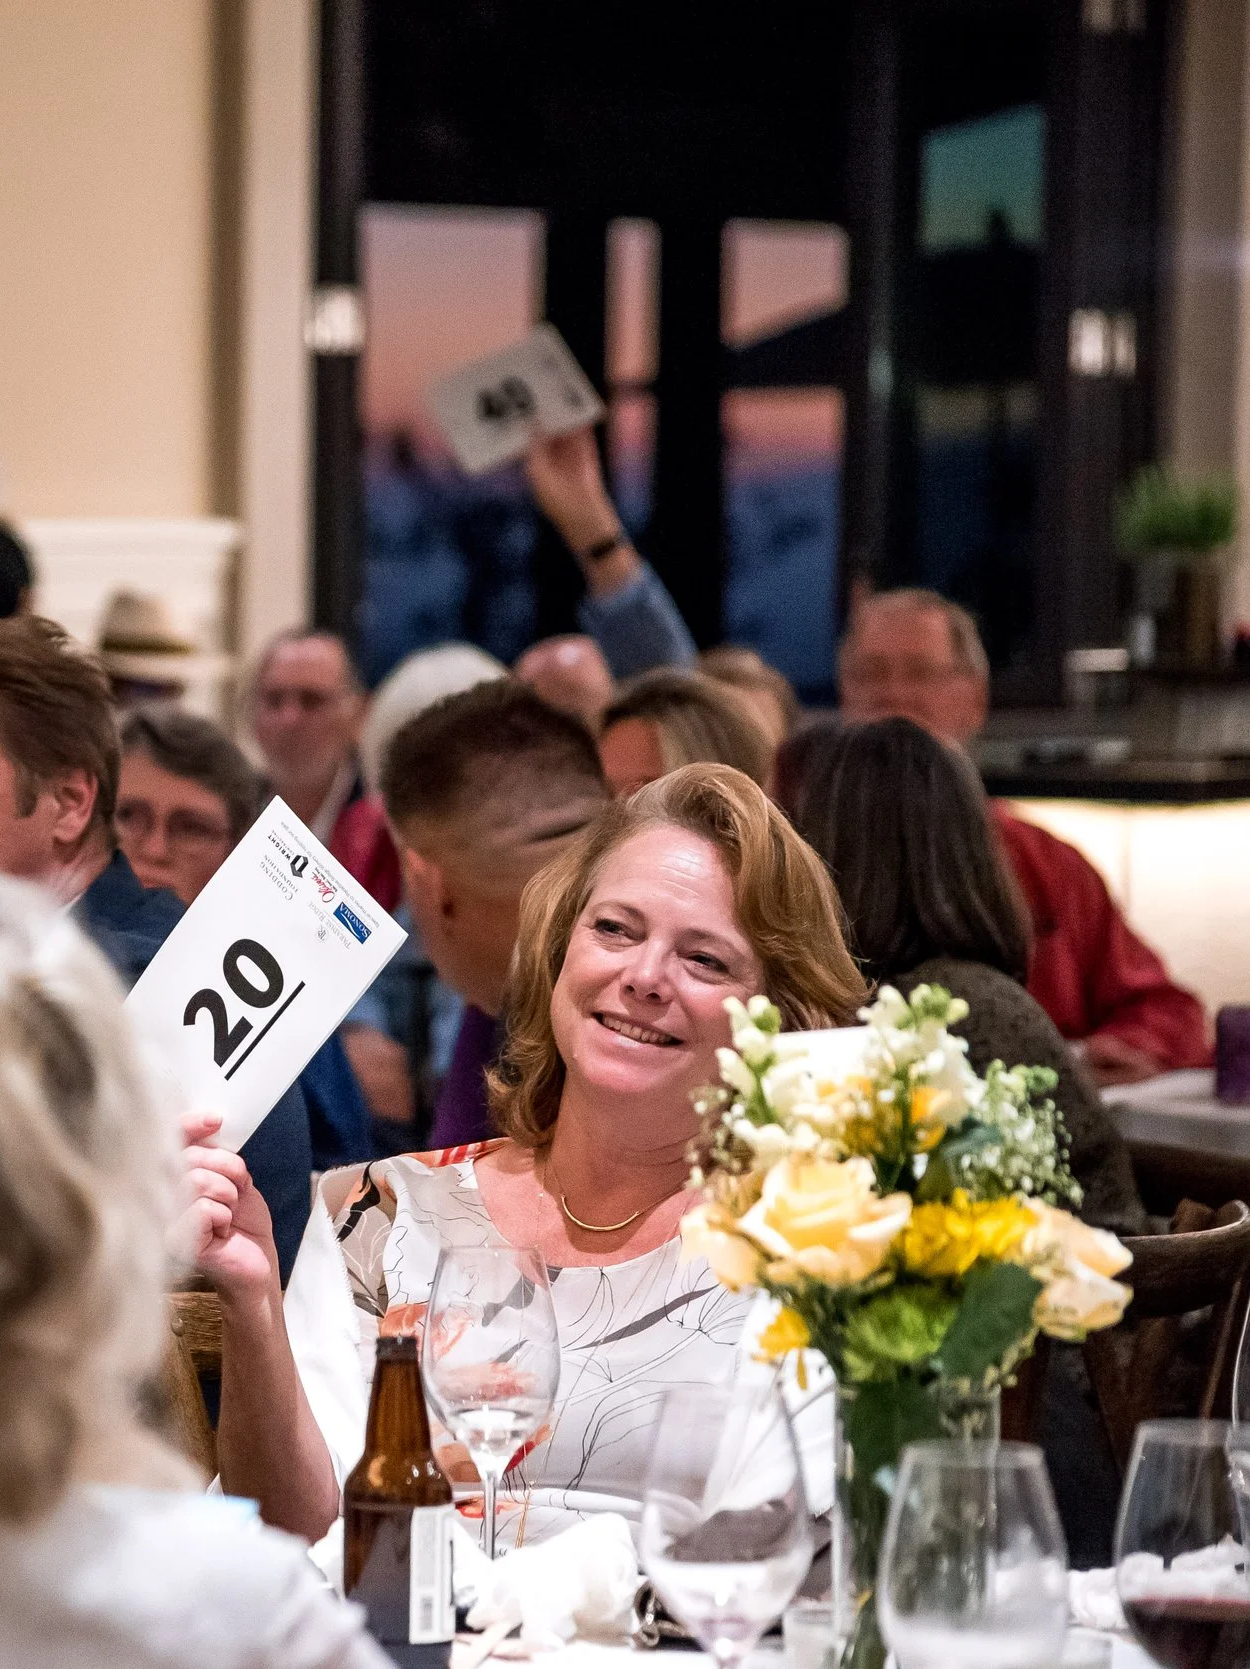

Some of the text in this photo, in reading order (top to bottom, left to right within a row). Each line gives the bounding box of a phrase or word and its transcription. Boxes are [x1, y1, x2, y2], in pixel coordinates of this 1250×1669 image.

[267, 834, 292, 860] WRIGHT
[259, 861, 294, 900] CODDING
[263, 854, 299, 893] FOUNDATION
[338, 902, 372, 937] SONOMA
[184, 939, 283, 1068] 20
